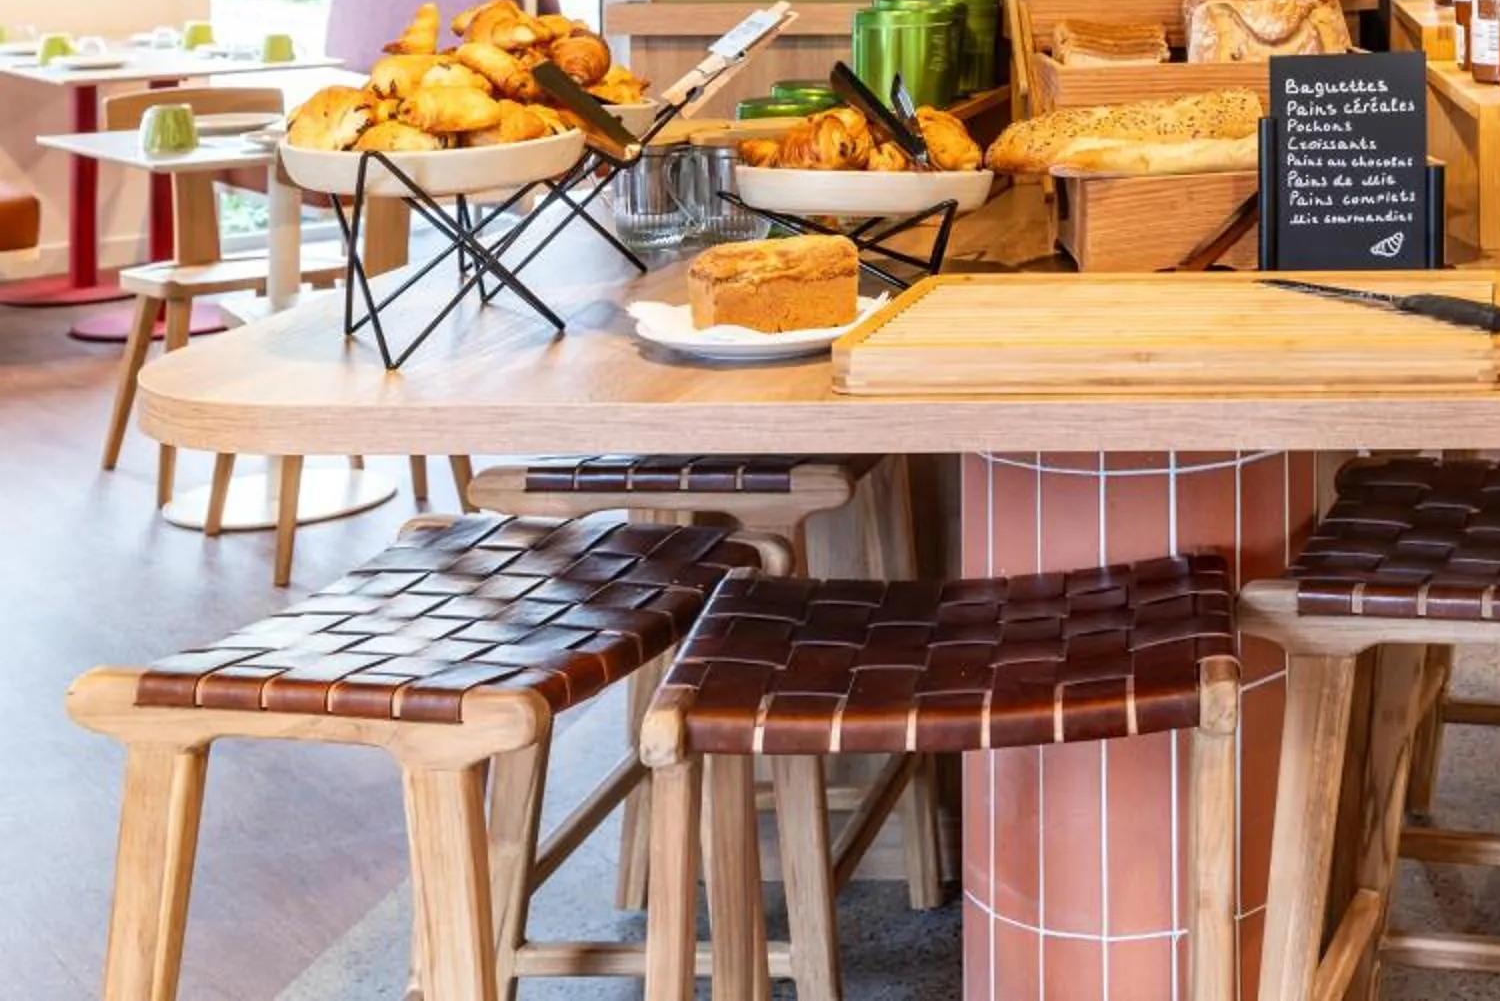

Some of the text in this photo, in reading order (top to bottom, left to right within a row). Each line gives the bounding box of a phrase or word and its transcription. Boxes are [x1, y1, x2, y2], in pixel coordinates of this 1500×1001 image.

[1285, 79, 1389, 97] Baguettes
[1287, 98, 1415, 116] Pains céréales
[1287, 118, 1353, 133] Pochons
[1287, 137, 1377, 150] Croissants
[1287, 153, 1323, 167] Pains
[1327, 159, 1347, 167] au
[1287, 170, 1328, 188] Pains
[1332, 174, 1353, 187] de
[1289, 190, 1416, 207] Pains complets
